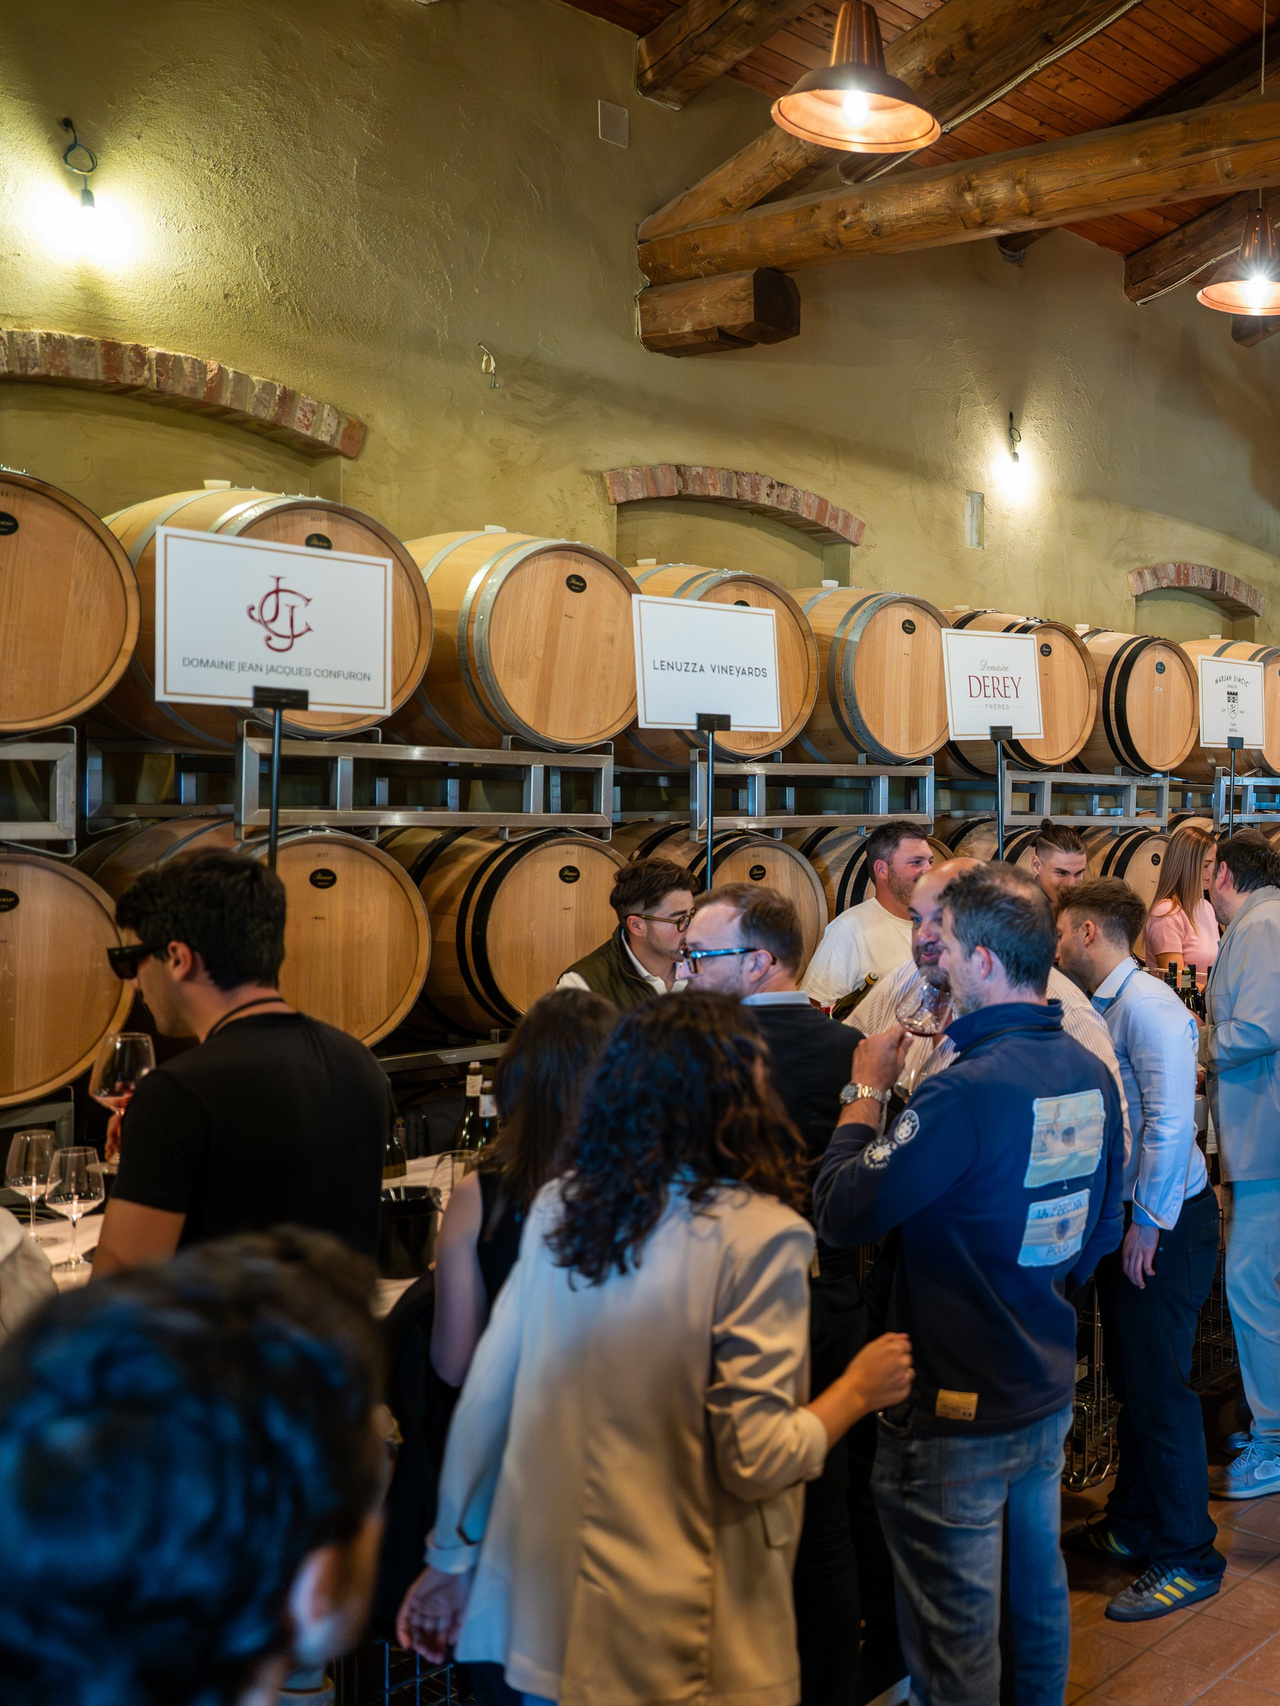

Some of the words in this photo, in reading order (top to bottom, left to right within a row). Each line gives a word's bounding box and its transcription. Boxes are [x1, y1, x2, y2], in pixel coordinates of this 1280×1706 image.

[182, 656, 236, 671] DOMAINE
[238, 661, 263, 674] JEAN
[265, 664, 312, 678] JACQUES
[313, 668, 371, 682] CONFURON
[653, 660, 705, 673] LENUZZA
[710, 663, 768, 678] VINEYARDS
[979, 659, 1010, 672] Domaine
[968, 675, 1021, 698] DEREY
